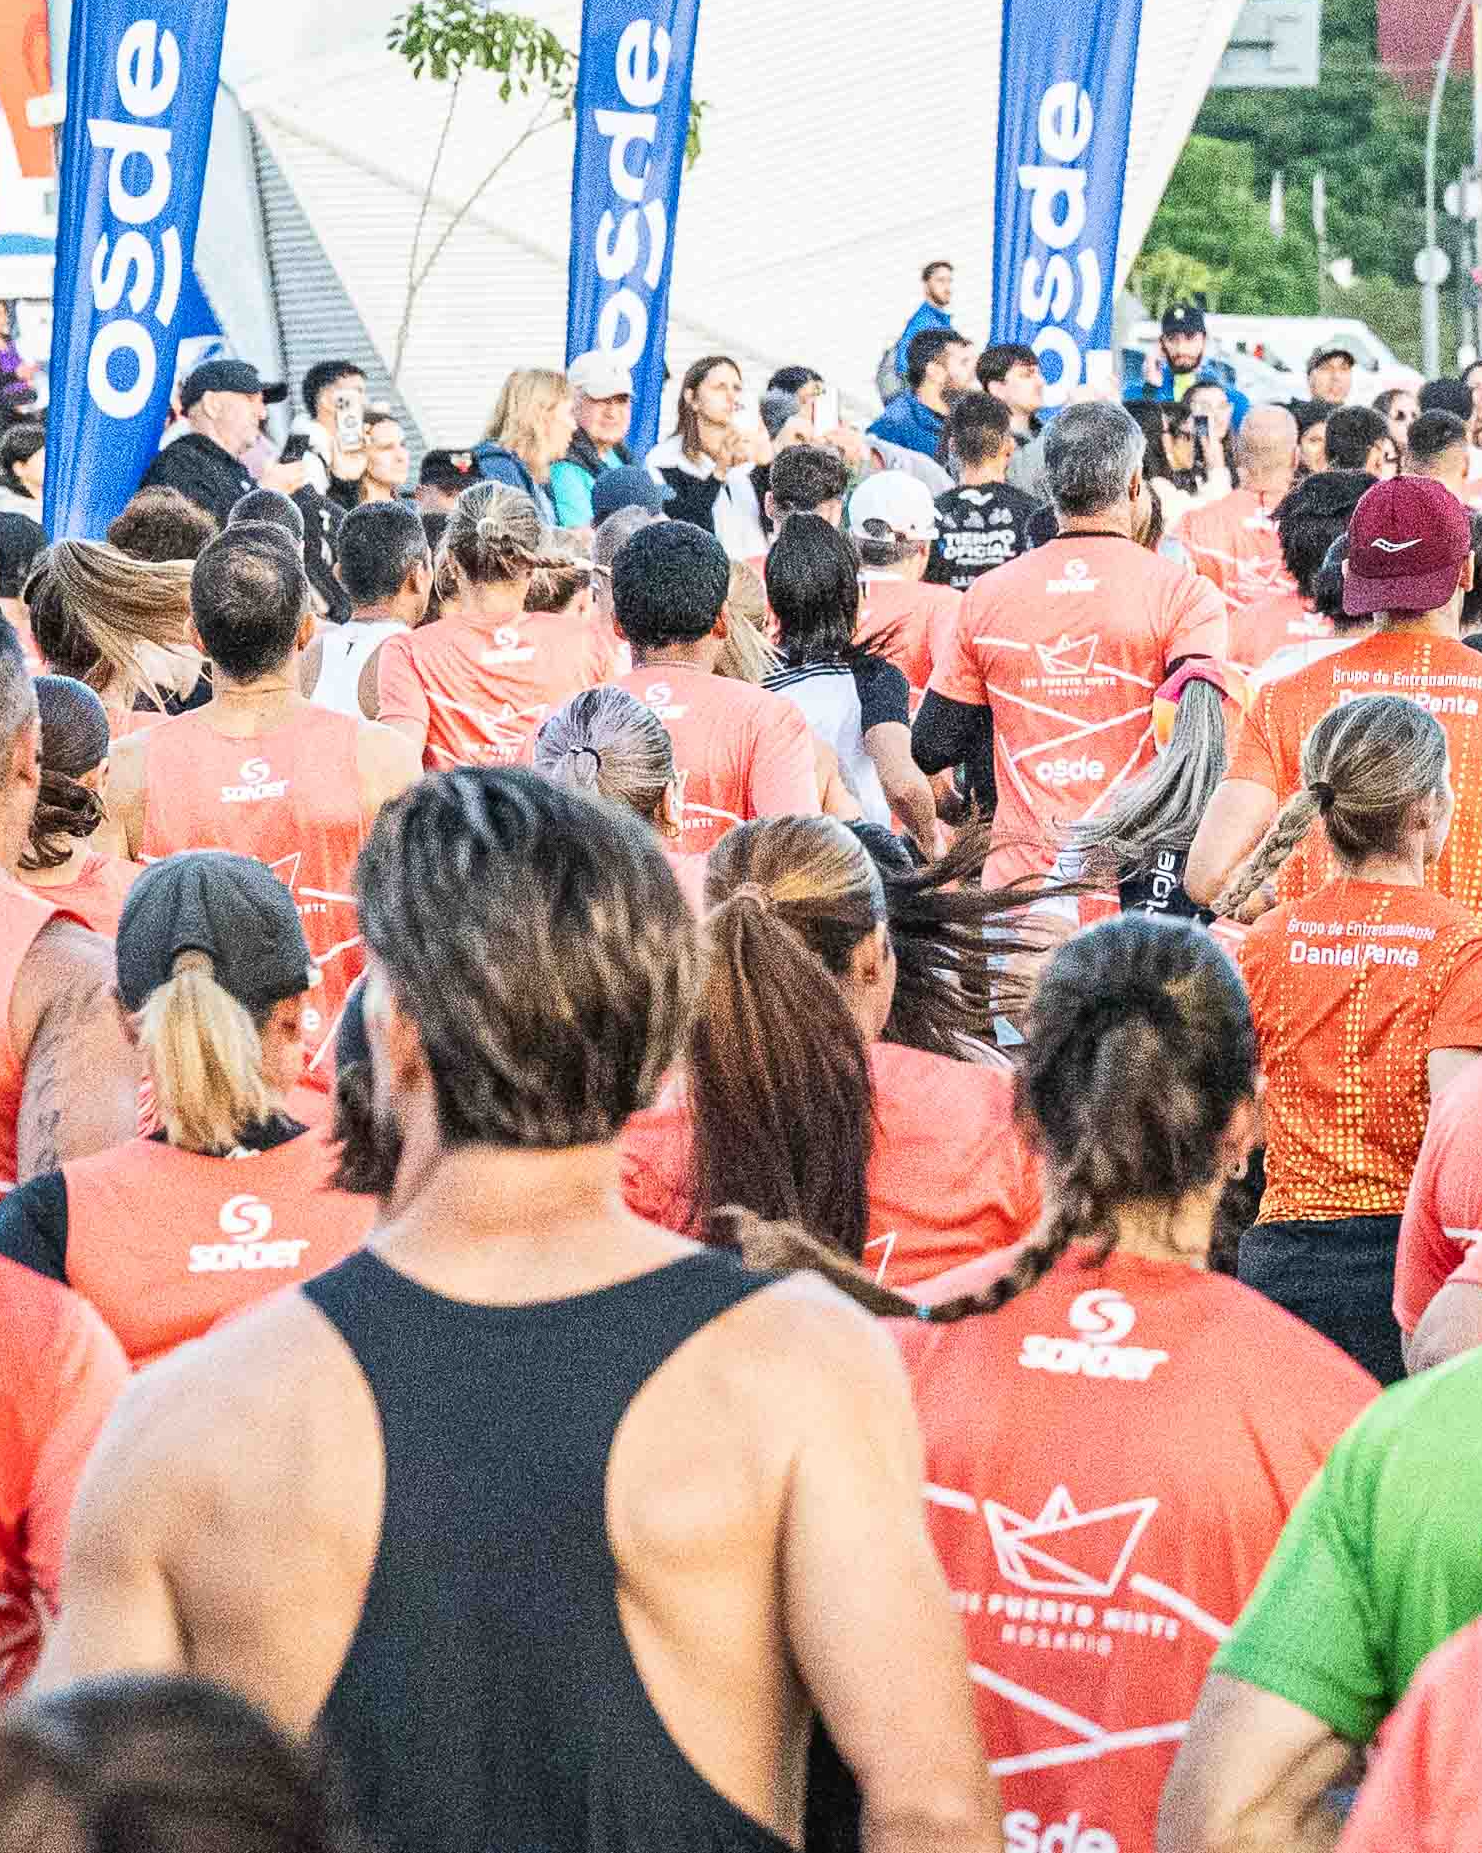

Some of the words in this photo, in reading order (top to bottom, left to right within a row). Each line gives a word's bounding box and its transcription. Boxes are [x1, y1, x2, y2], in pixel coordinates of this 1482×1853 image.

[88, 19, 182, 419] osde
[1333, 666, 1370, 685] Grupo
[1373, 669, 1389, 685] de
[1035, 754, 1106, 785] osde
[1287, 918, 1325, 937] Grupo
[1328, 921, 1344, 937] de
[1346, 920, 1436, 941] Entrenamiento
[1289, 941, 1360, 965] Daniel
[1363, 944, 1420, 967] Penta
[987, 1593, 1095, 1627] PUERTO
[1000, 1798, 1116, 1853] sde
